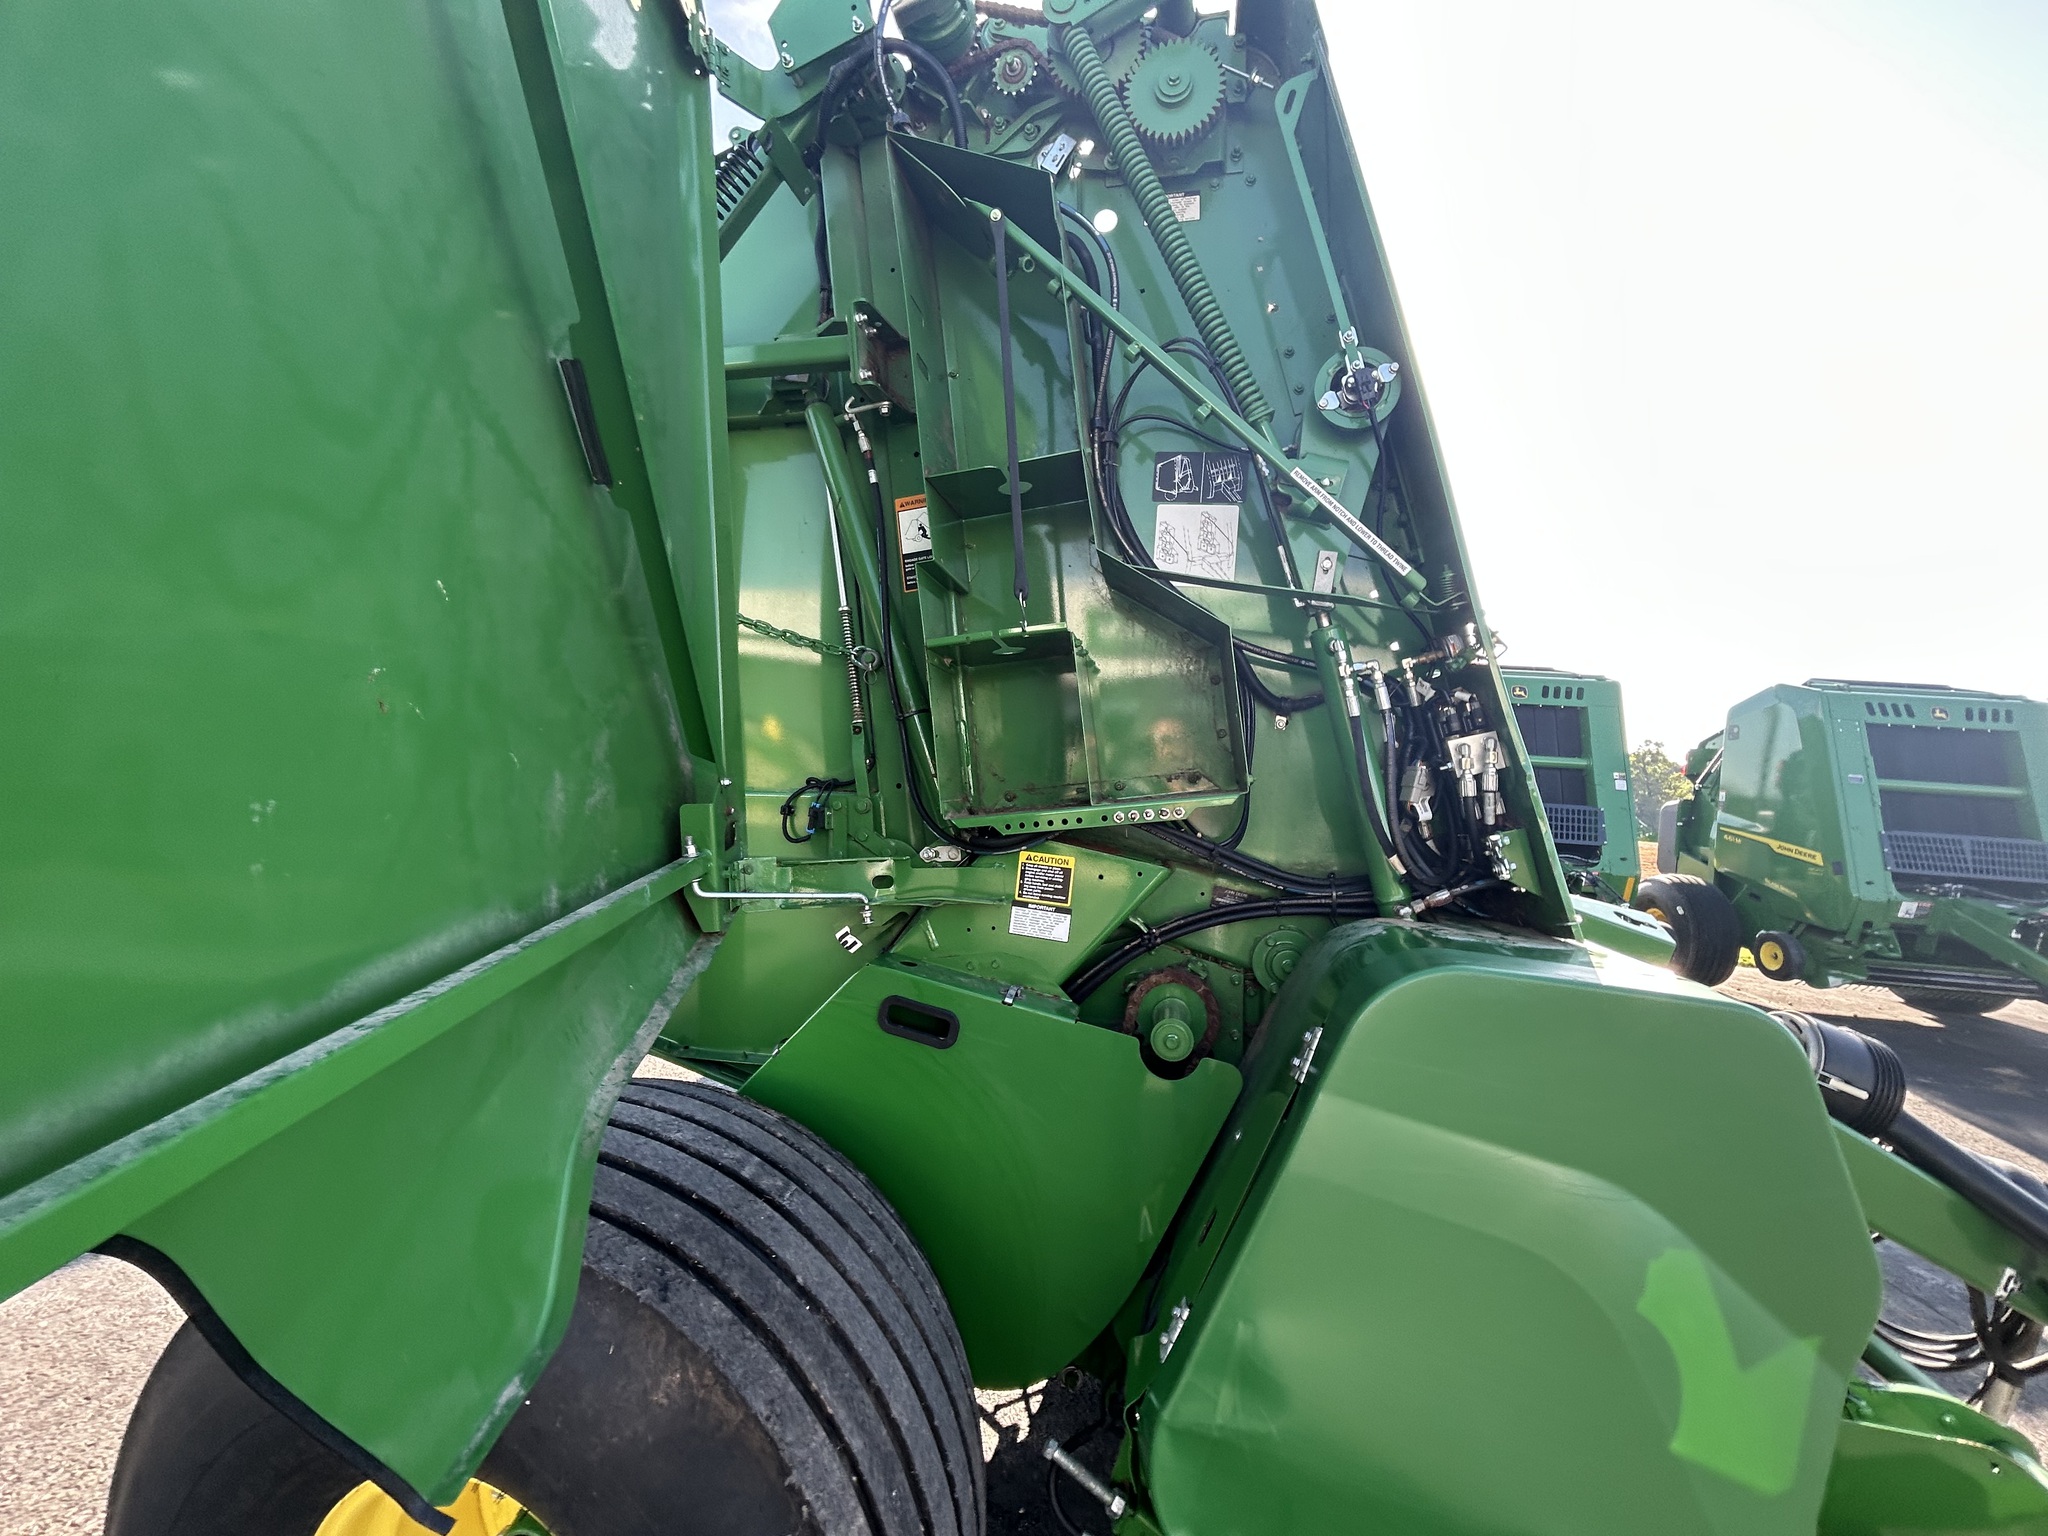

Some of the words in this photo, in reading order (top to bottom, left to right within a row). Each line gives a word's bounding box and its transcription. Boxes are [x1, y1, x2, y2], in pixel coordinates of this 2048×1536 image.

[1293, 470, 1312, 488] REMOVE
[1309, 484, 1322, 497] ARM
[1319, 493, 1334, 507] FROM
[1331, 504, 1348, 520] NOTCH
[1345, 516, 1357, 527] AND
[1354, 524, 1372, 541] LOWER
[1370, 537, 1378, 546] TO
[1375, 542, 1395, 561] THREAD
[1392, 557, 1408, 573] TWINE
[1777, 844, 1794, 853] JOHN
[1794, 848, 1817, 860] DEERE
[1033, 855, 1069, 865] CAUTION
[1028, 903, 1056, 912] IMPORTANT
